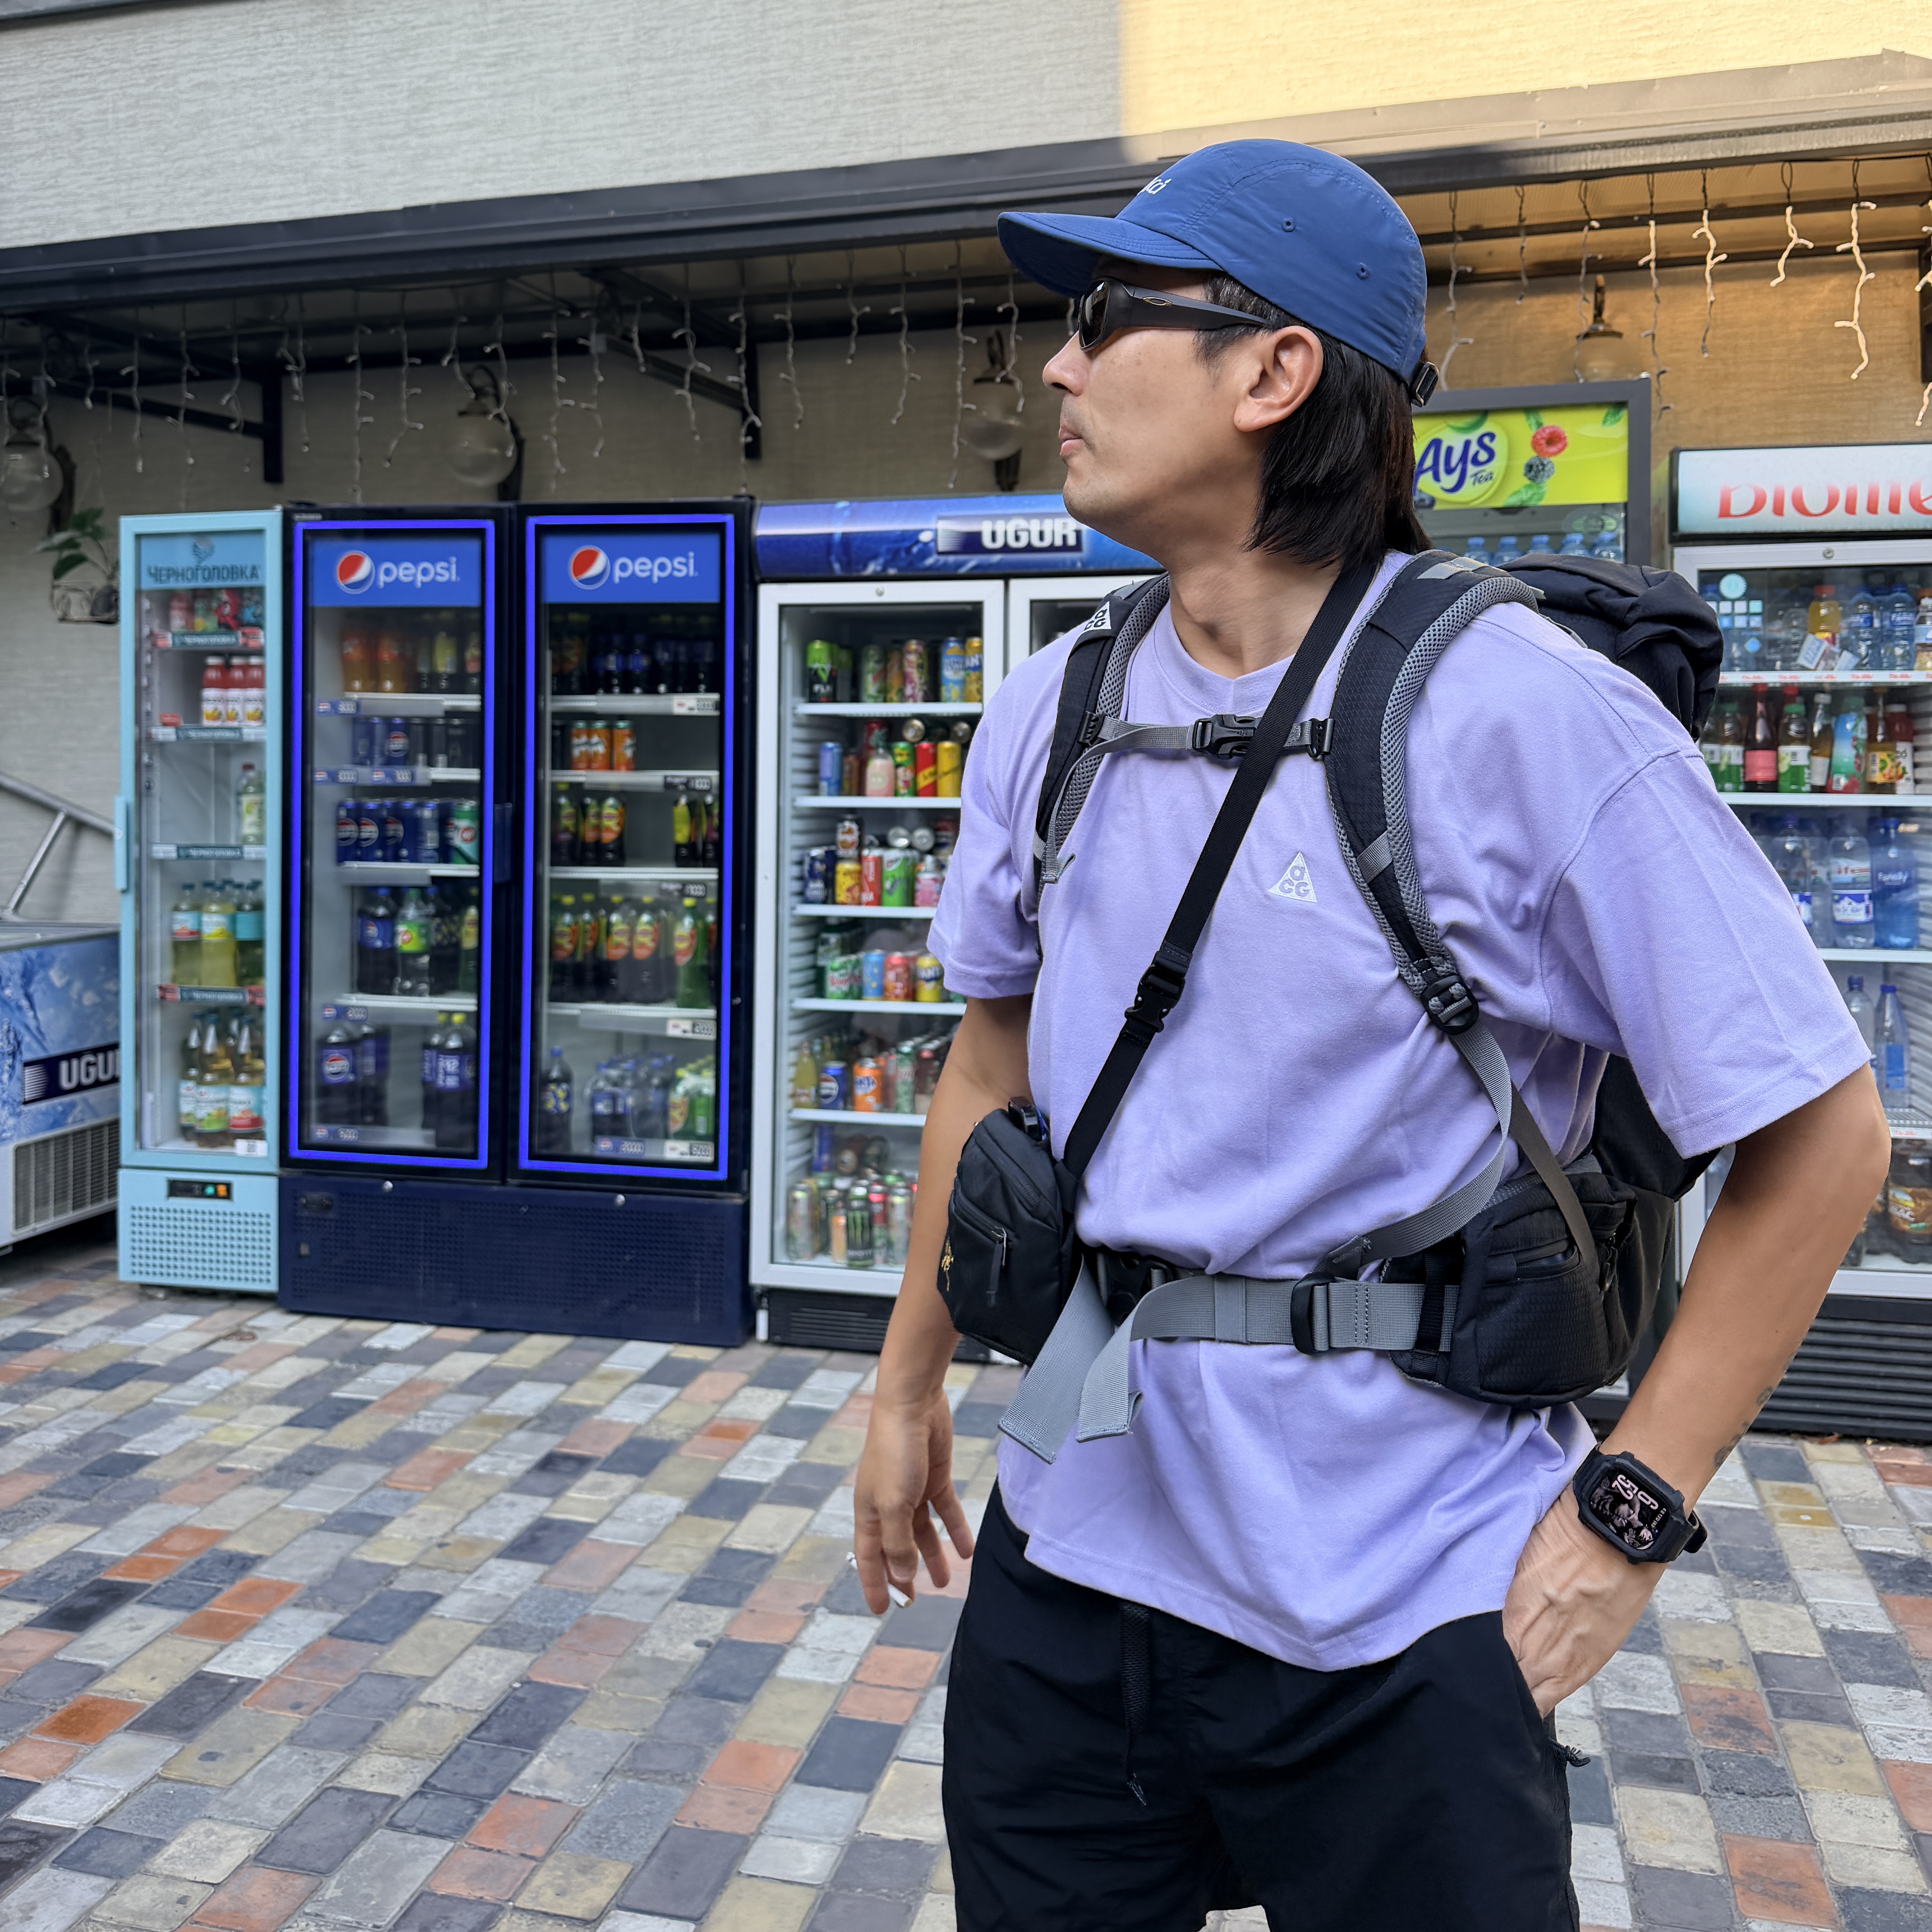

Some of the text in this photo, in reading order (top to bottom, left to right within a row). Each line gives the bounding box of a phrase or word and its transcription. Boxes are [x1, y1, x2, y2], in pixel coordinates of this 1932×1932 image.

[1412, 431, 1496, 497] Ays
[1470, 468, 1494, 486] Tea
[147, 563, 259, 584] ЧЕРНОГОЛОВКА
[378, 556, 457, 588] pepsi
[613, 551, 695, 584] pepsi
[1611, 1474, 1639, 1500] 52
[1637, 1491, 1659, 1510] 6
